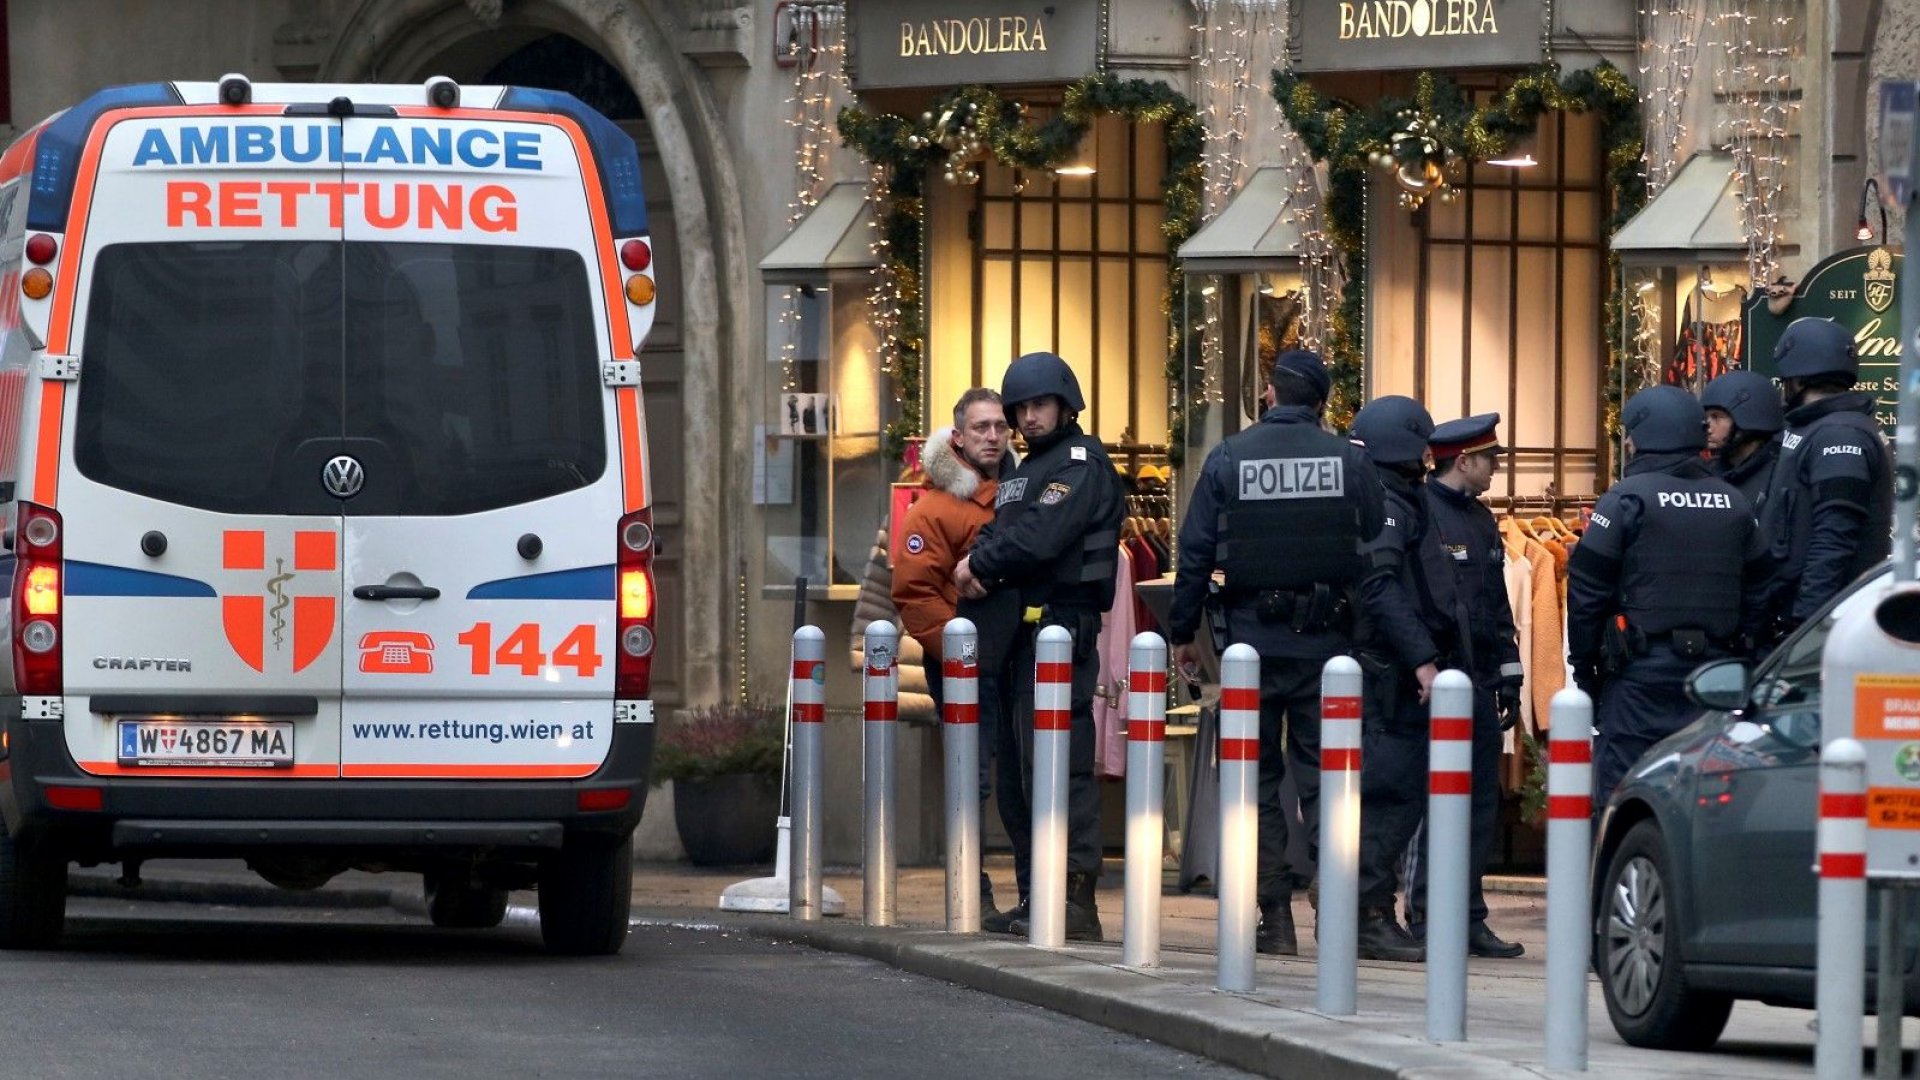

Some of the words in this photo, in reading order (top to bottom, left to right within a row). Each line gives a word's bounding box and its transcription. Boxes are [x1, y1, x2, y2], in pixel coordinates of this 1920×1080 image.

[1338, 0, 1498, 39] BANDOLERA
[900, 16, 1048, 57] BANDOLERA
[132, 124, 543, 171] AMBULANCE
[166, 180, 519, 233] RETTUNG
[1829, 289, 1857, 300] SEIT
[1848, 380, 1879, 392] este
[1874, 411, 1898, 427] Sch
[1823, 445, 1862, 456] POLIZEI
[1242, 460, 1341, 495] POLIZEI
[1657, 491, 1732, 509] POLIZEI
[458, 622, 603, 677] 144
[93, 656, 192, 673] CRAFTER
[140, 728, 158, 754] W
[179, 728, 245, 755] 4867
[251, 729, 287, 755] MA
[352, 719, 594, 744] www.rettung.wienat
